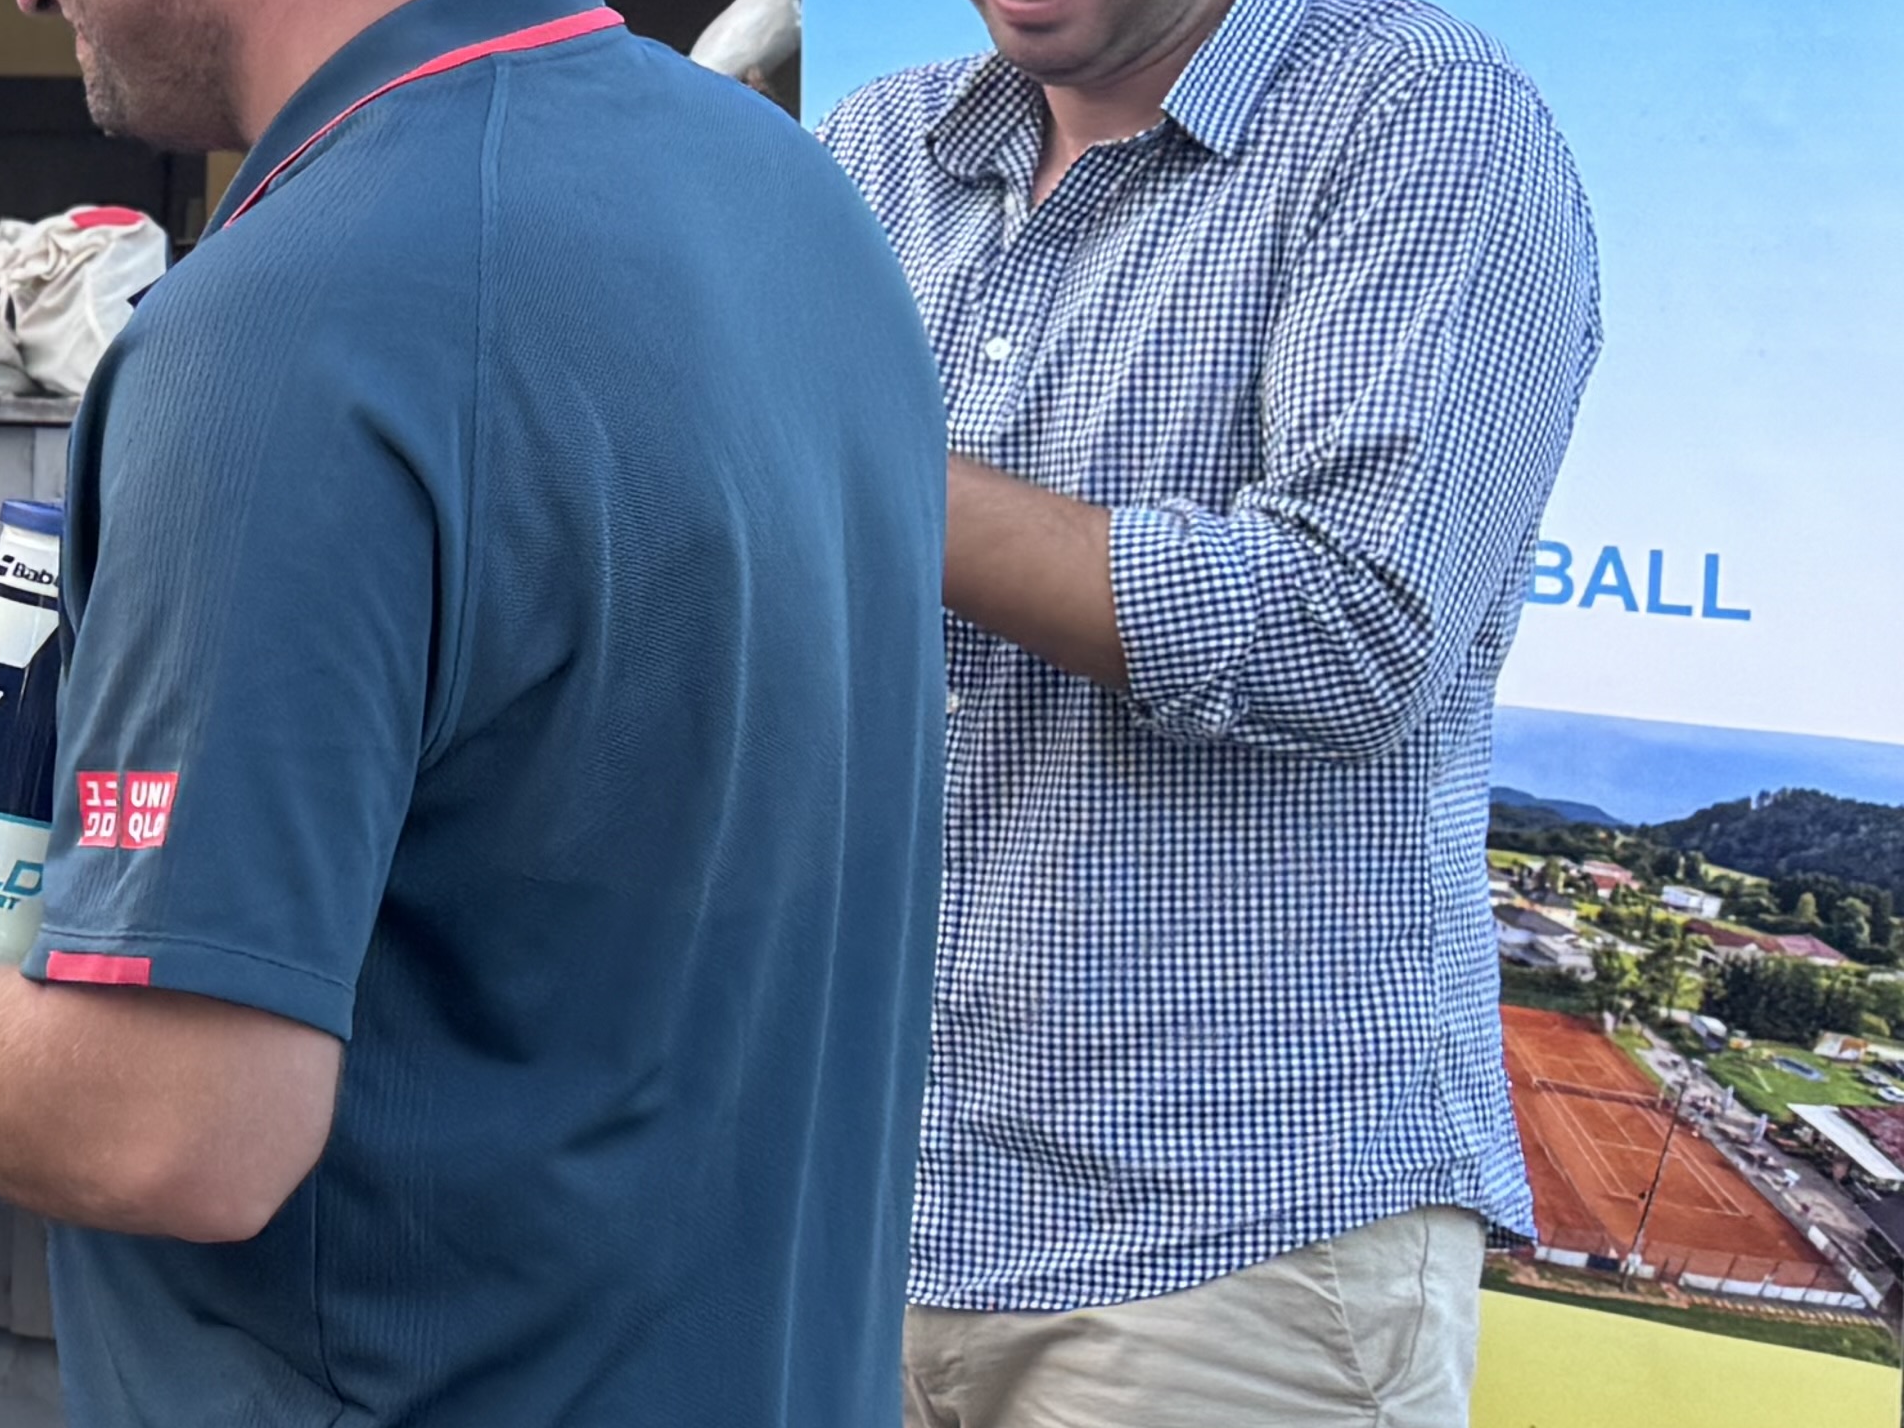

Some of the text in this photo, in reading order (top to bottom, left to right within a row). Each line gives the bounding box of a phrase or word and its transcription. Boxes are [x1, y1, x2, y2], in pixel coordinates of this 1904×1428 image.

[1524, 539, 1752, 621] BALL
[130, 781, 172, 808] UNI
[128, 812, 167, 844] QLO
